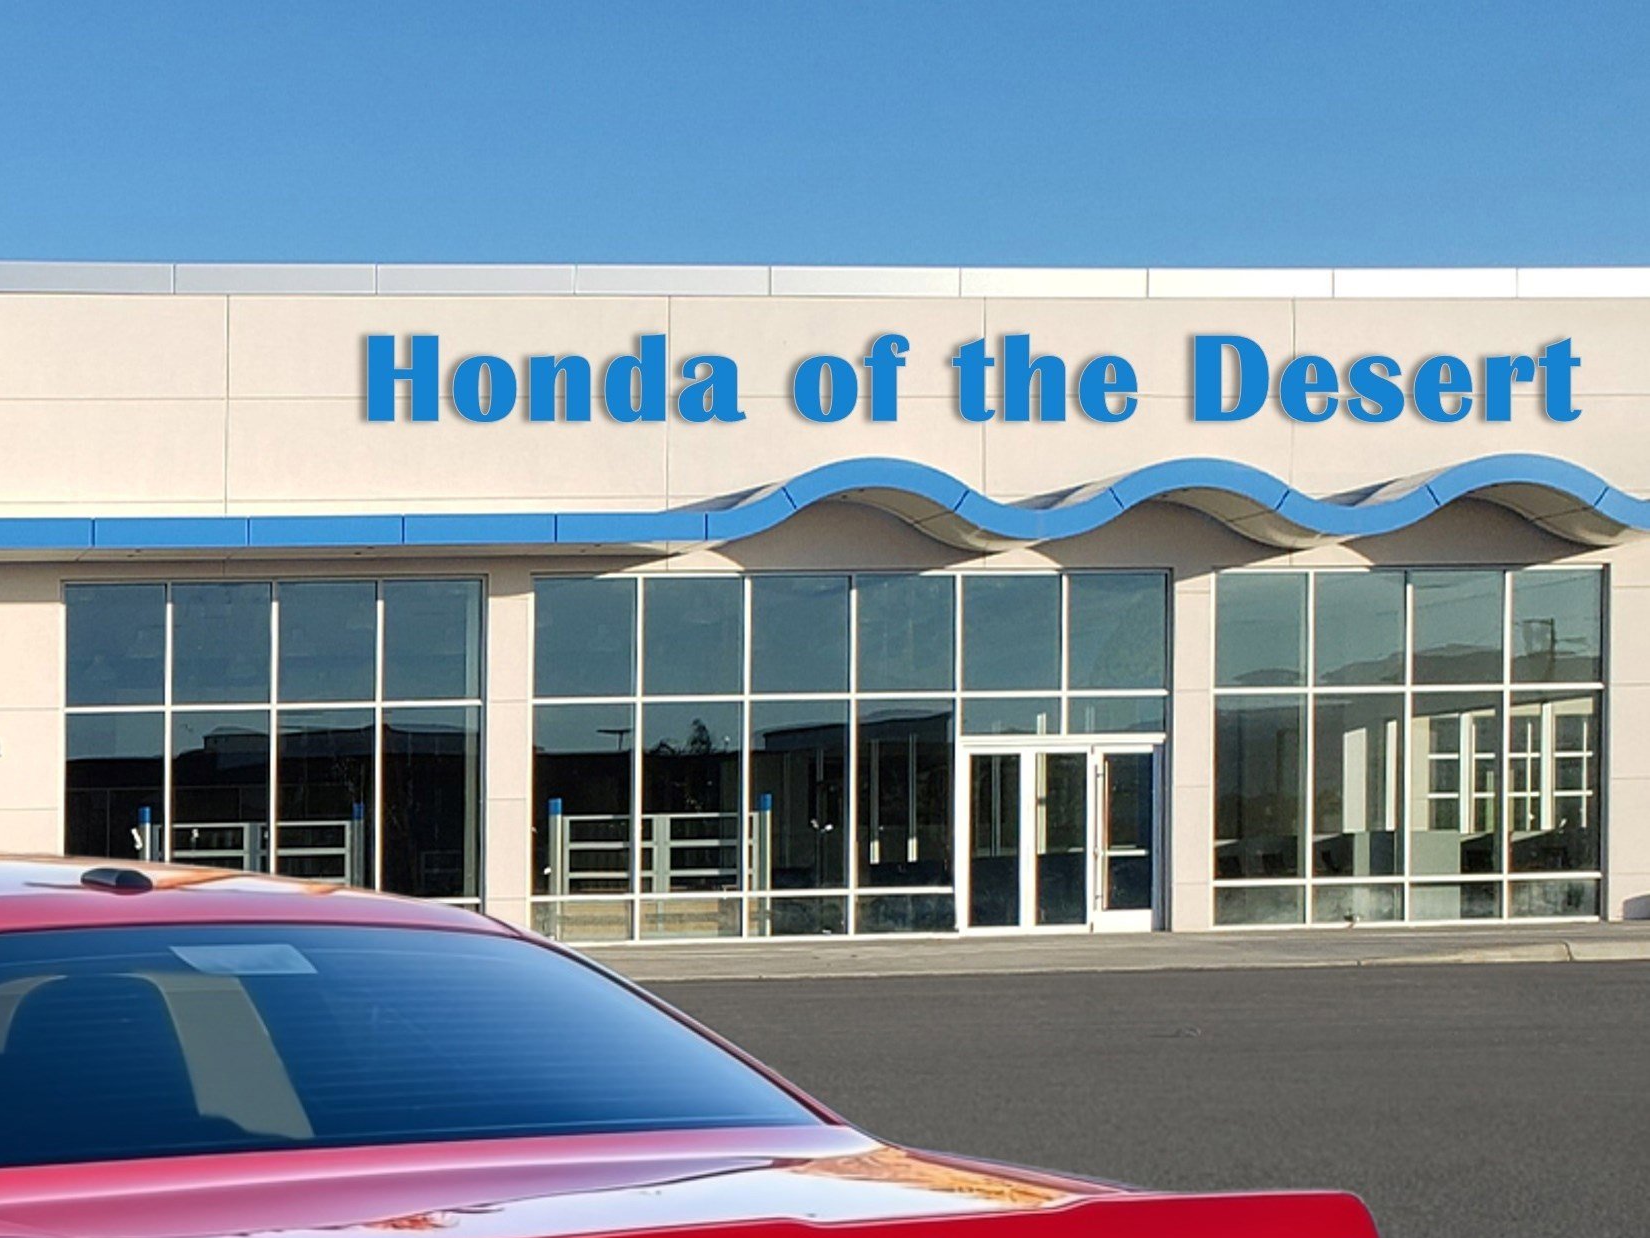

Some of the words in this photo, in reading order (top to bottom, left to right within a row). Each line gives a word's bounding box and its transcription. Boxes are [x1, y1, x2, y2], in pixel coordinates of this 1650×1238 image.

[366, 333, 747, 423] Honda
[792, 333, 911, 423] of
[951, 333, 1139, 423] the
[1193, 334, 1584, 423] Desert
